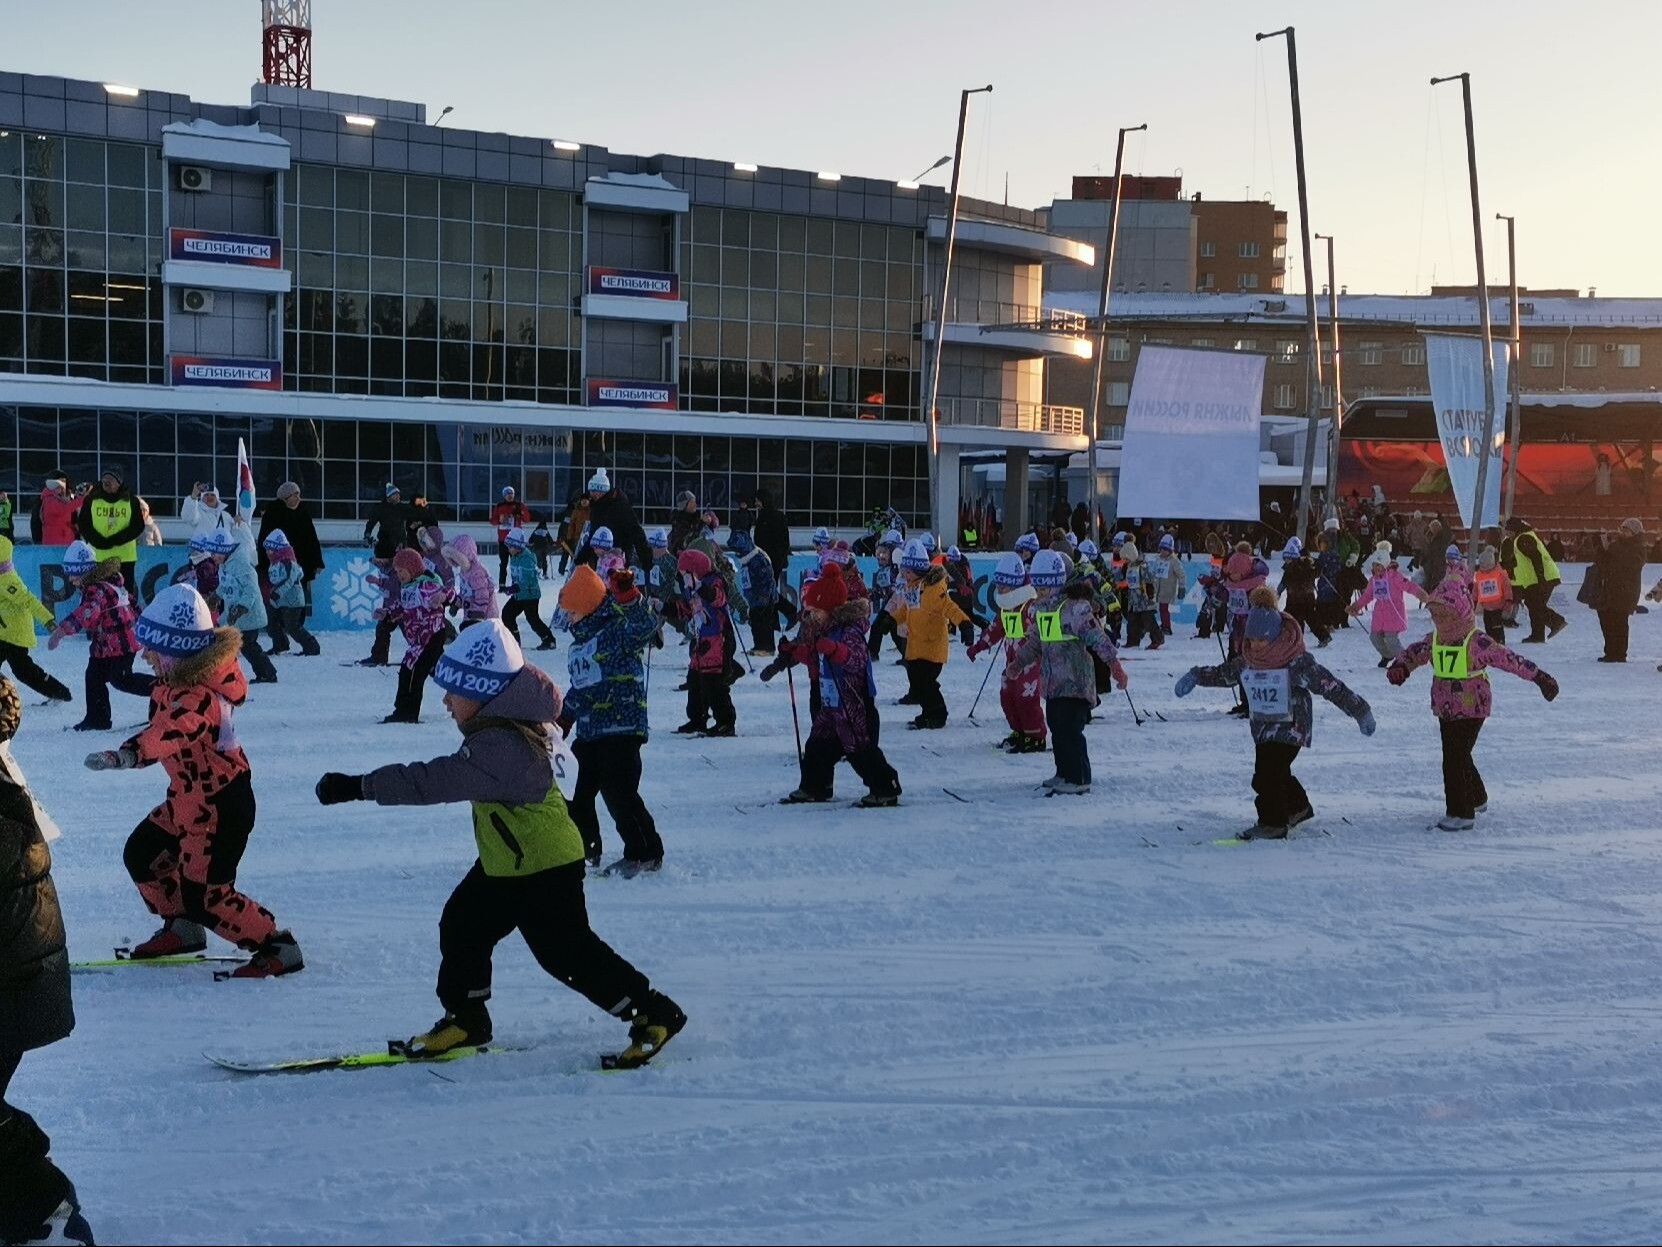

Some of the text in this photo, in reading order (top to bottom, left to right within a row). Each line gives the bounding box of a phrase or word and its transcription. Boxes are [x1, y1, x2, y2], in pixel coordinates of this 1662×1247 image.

[186, 240, 269, 257] ЧЕЛЯБИНСК
[602, 276, 668, 291] ЧЕЛЯБИНСК
[186, 366, 269, 380] ЧЕЛЯБИНСК
[600, 388, 667, 400] ЧЕЛЯБИНСК
[1005, 615, 1018, 634] 17
[1040, 615, 1054, 638] 17
[1438, 649, 1460, 673] 17
[436, 661, 463, 687] ИИ
[1251, 687, 1279, 703] 2412
